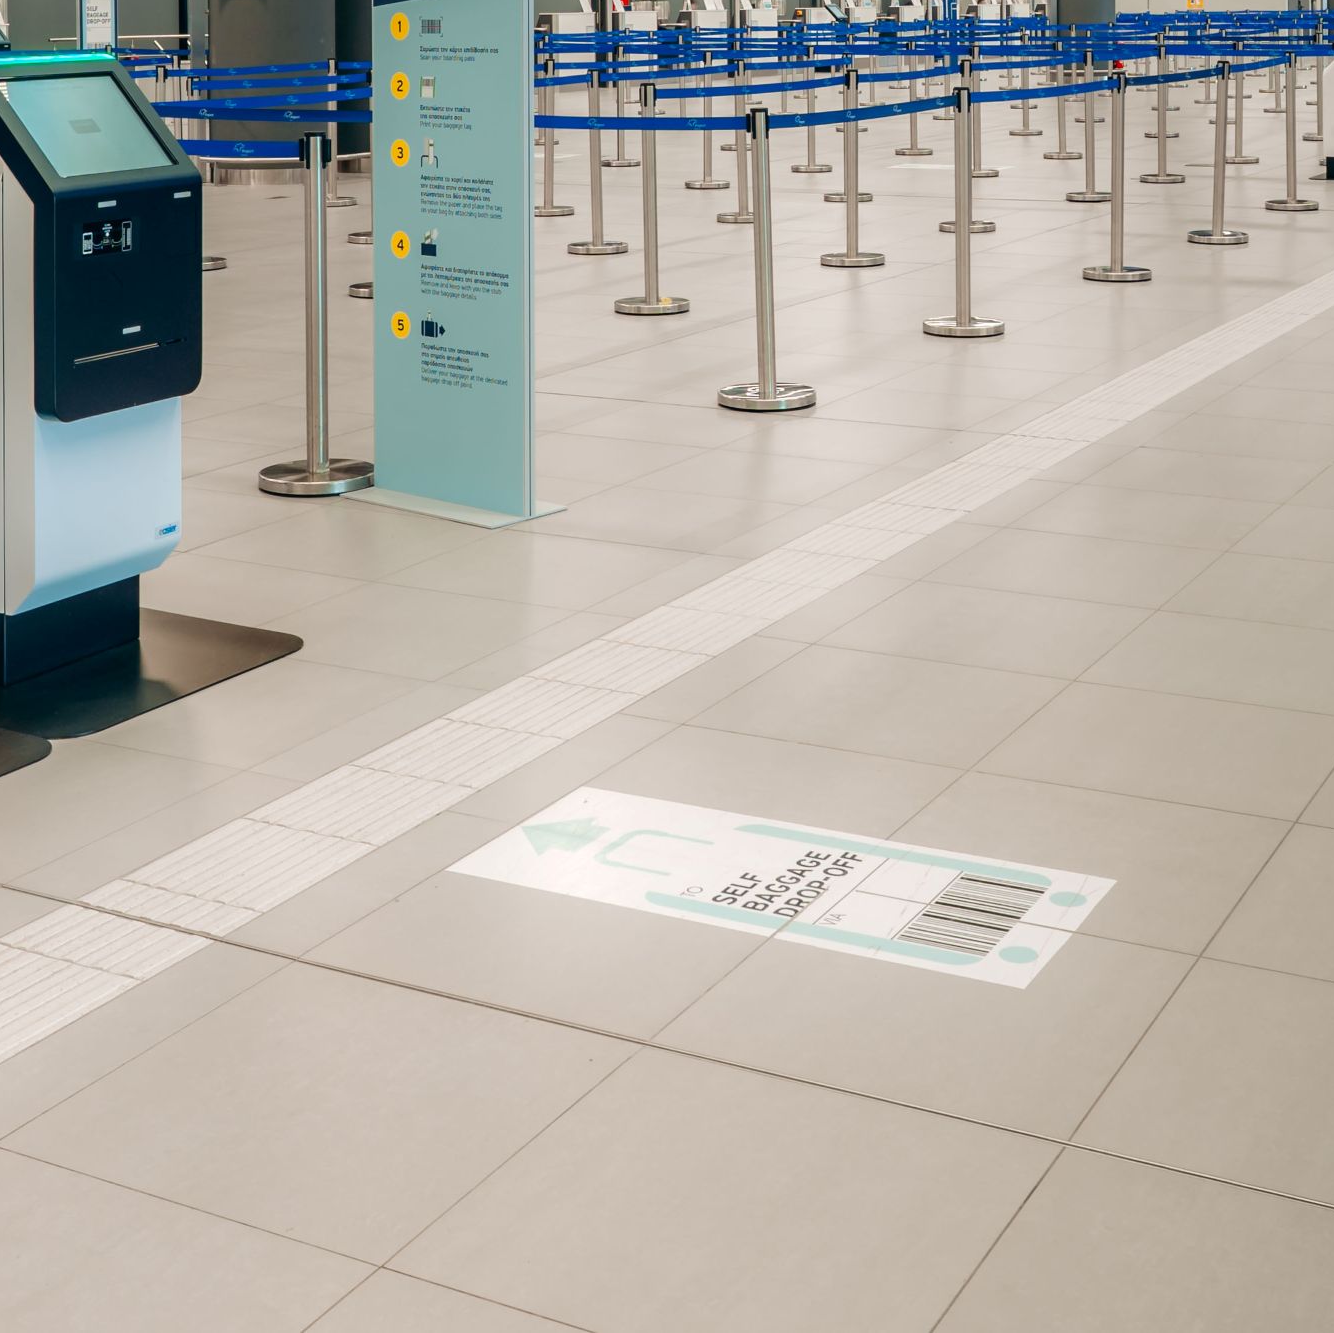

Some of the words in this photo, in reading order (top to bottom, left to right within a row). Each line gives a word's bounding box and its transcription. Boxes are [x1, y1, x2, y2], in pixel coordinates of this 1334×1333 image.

[398, 20, 402, 33] 1
[397, 80, 404, 92] 2
[397, 147, 404, 159] 3
[397, 239, 404, 251] 4
[397, 319, 405, 331] 5
[742, 850, 832, 912] BAGGAGE
[773, 851, 863, 918] DROP-OFF
[680, 885, 704, 897] TO
[712, 872, 762, 905] SELF
[819, 913, 847, 926] VIA
